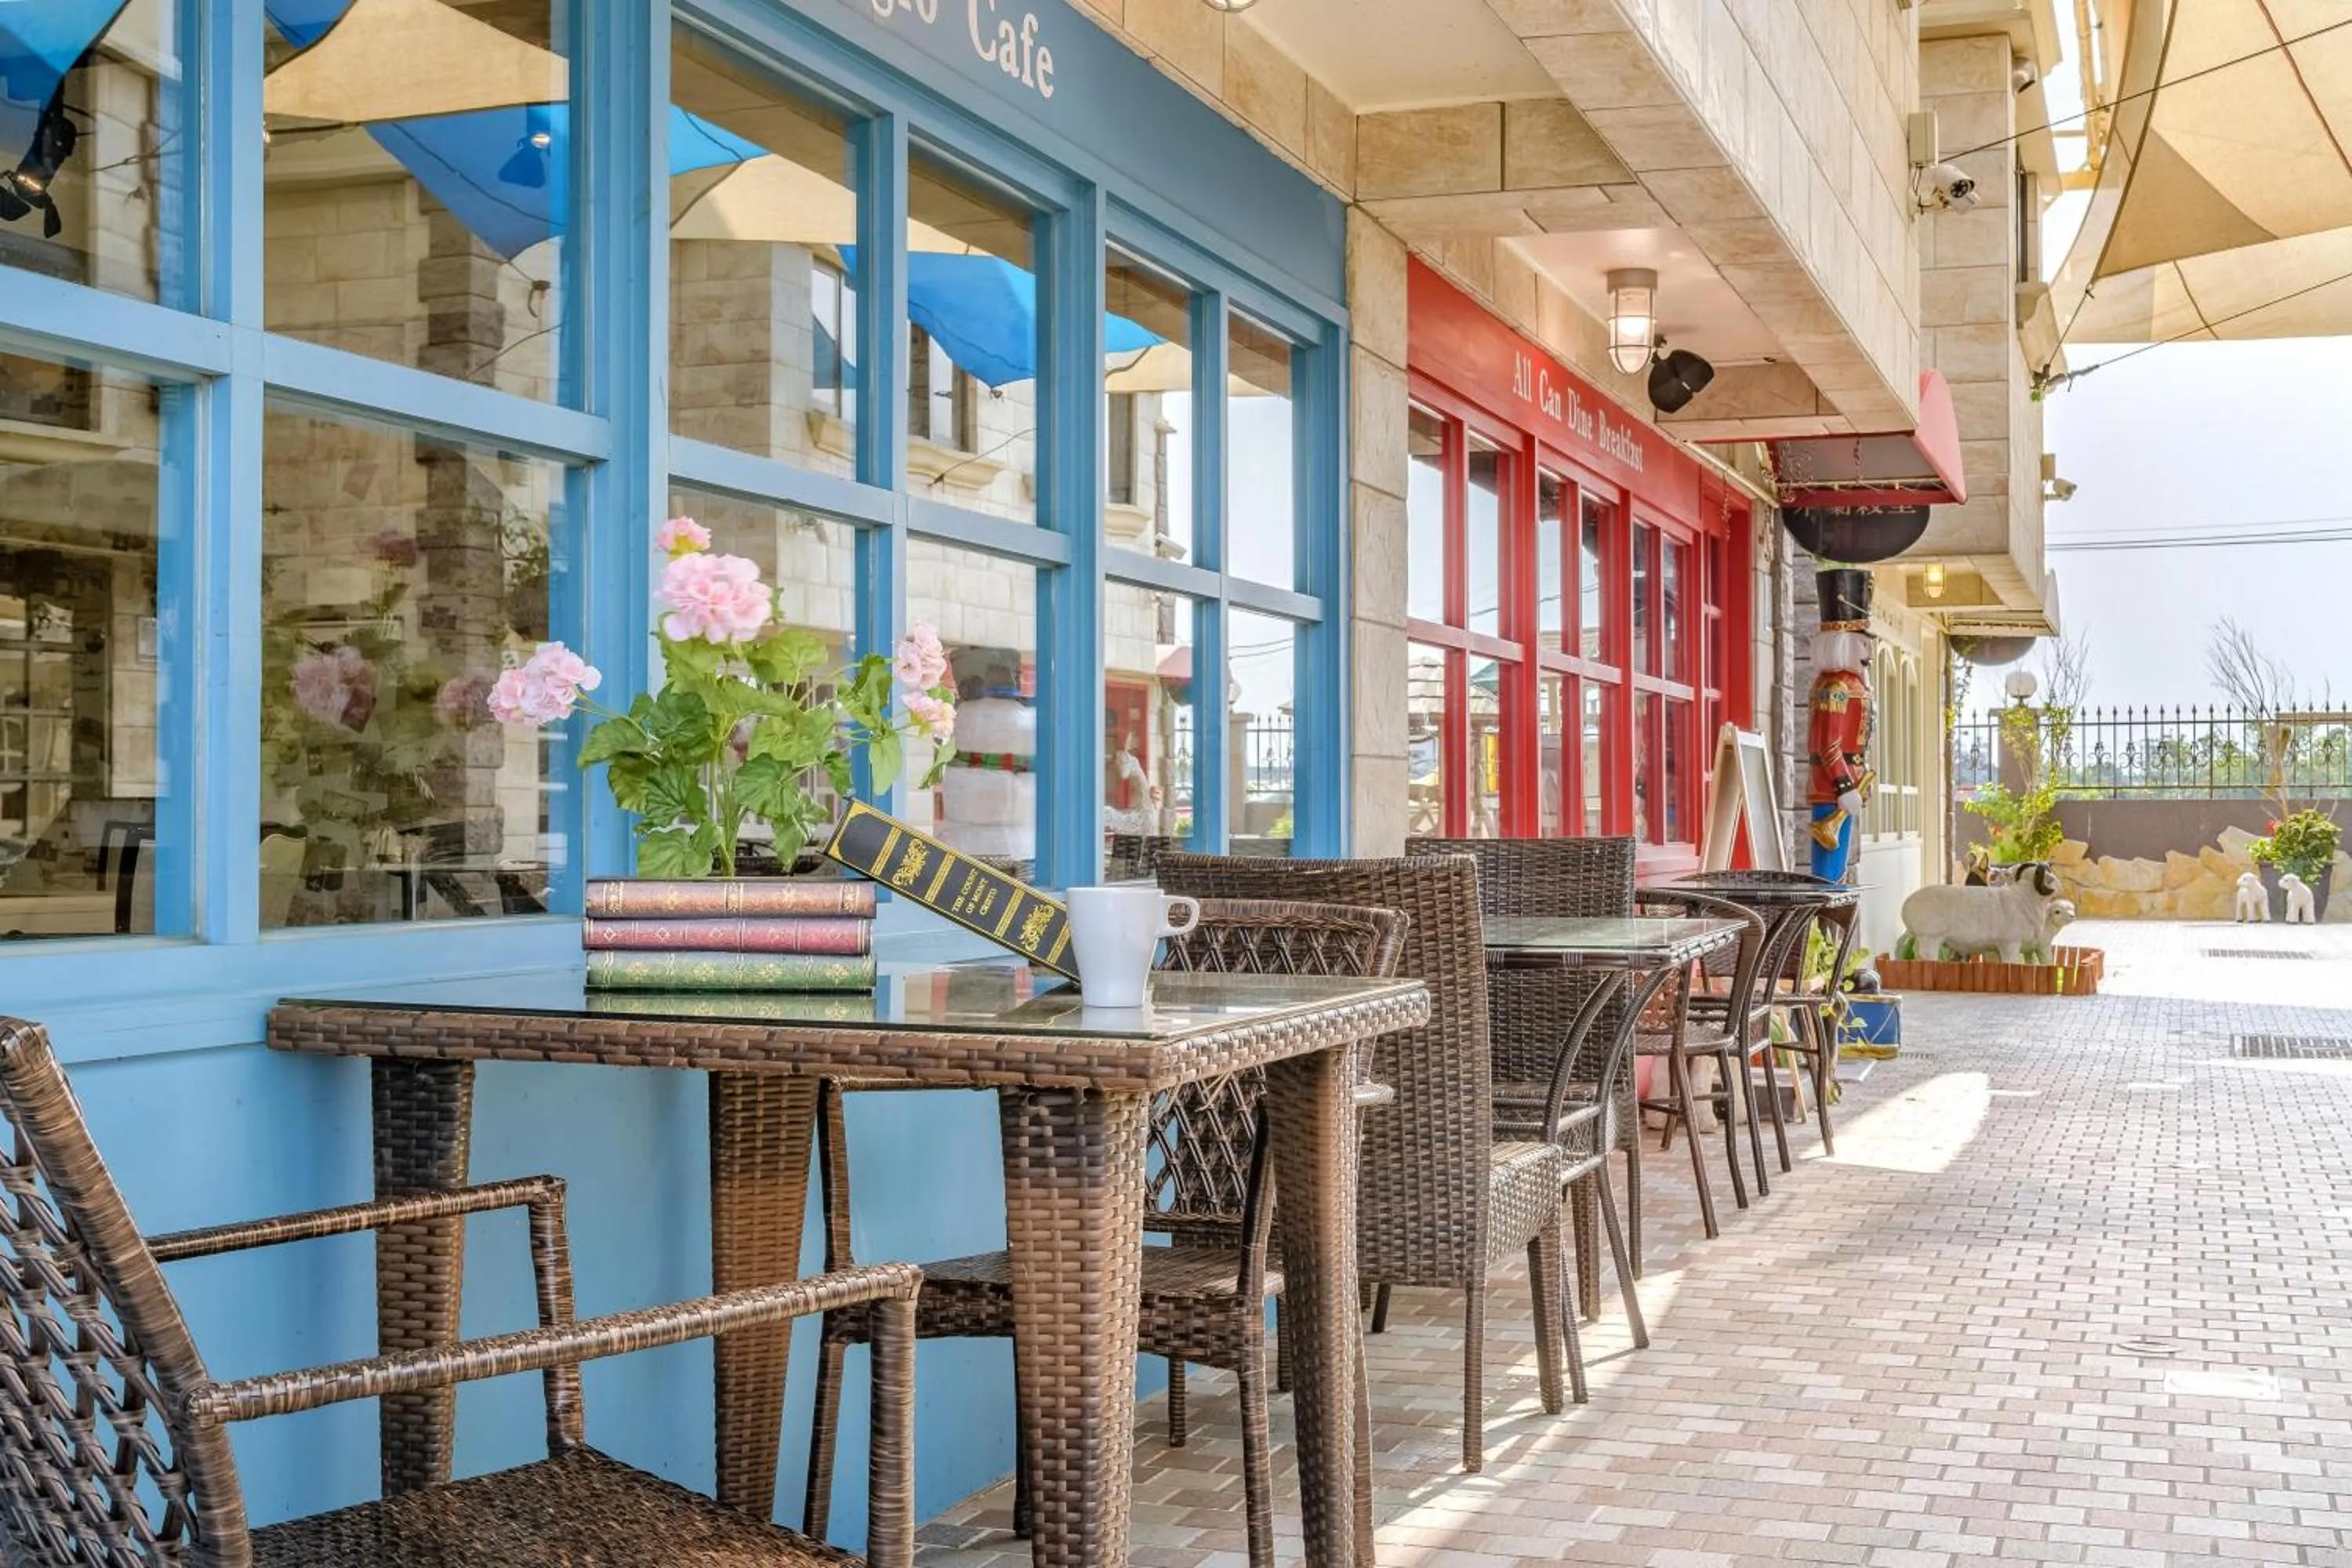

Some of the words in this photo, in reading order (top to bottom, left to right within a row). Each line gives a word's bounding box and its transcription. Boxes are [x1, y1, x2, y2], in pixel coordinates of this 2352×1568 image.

[967, 0, 1054, 99] Cafe
[1512, 350, 1532, 404] All
[1539, 368, 1562, 423] Can
[1567, 387, 1593, 441] Dine
[1598, 408, 1643, 474] Breakfast
[965, 902, 975, 913] OF
